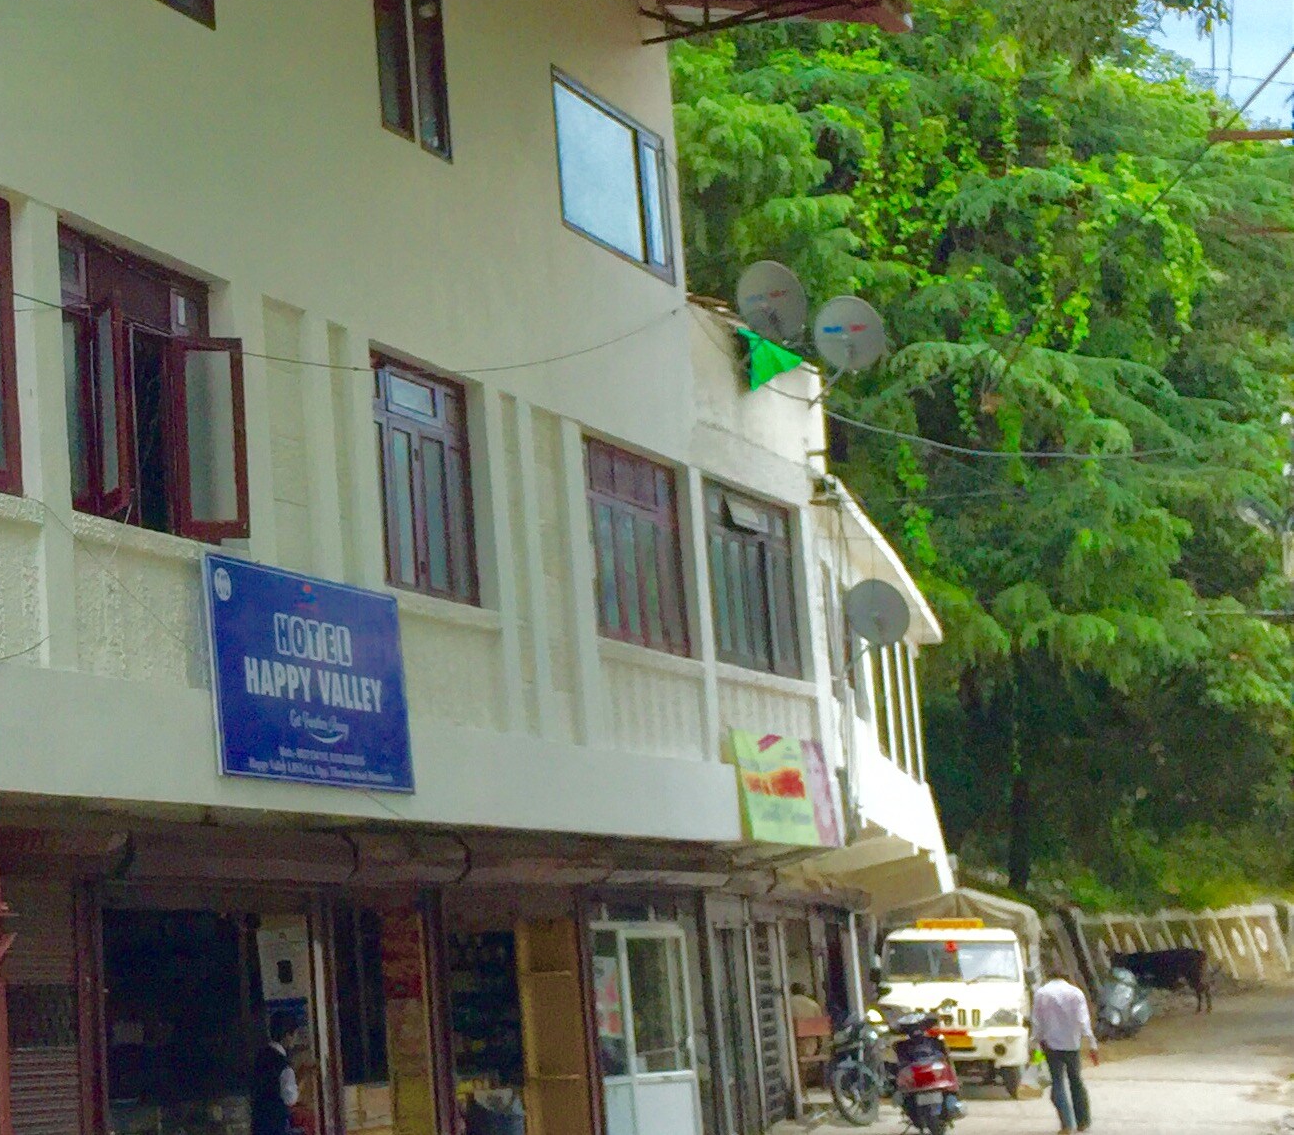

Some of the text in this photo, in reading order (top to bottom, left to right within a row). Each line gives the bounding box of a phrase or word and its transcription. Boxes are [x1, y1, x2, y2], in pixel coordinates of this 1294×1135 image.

[274, 612, 352, 667] HOTEL
[244, 656, 382, 713] HAPPY VALLEY
